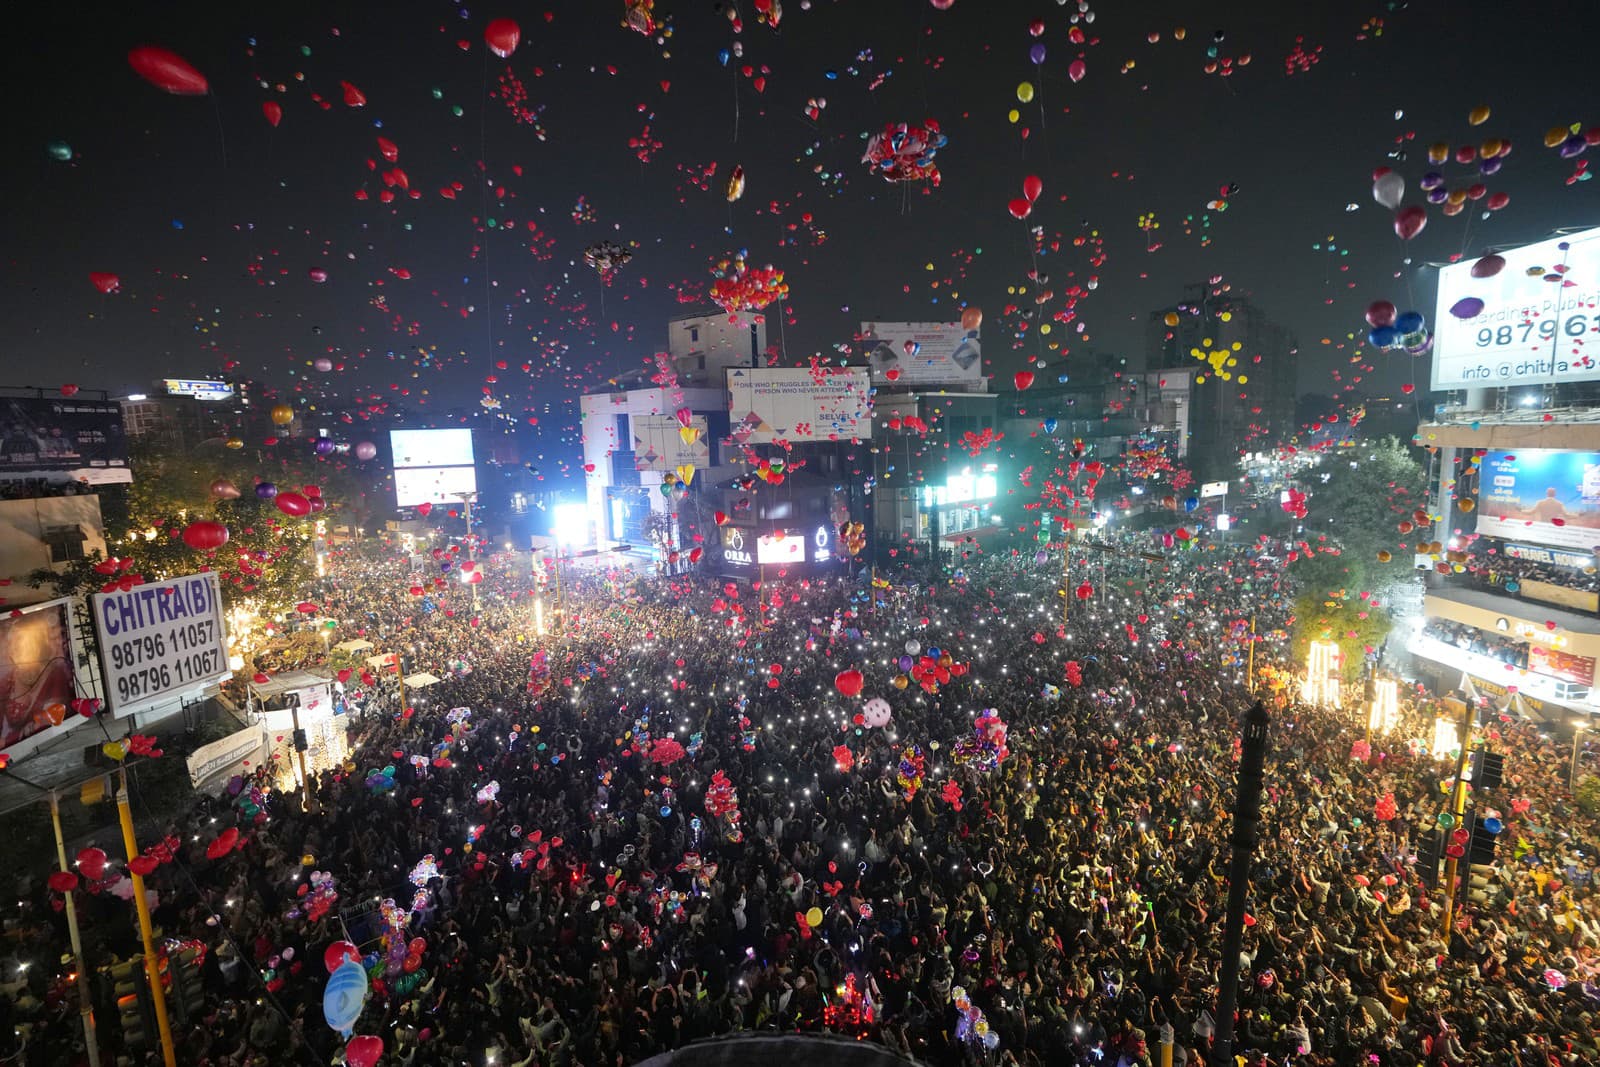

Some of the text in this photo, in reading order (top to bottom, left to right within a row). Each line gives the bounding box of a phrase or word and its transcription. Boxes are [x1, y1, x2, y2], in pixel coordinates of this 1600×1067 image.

[102, 577, 212, 636] CHITRA(B)
[112, 620, 214, 670] 98796 11057
[118, 648, 218, 702] 98796 11067
